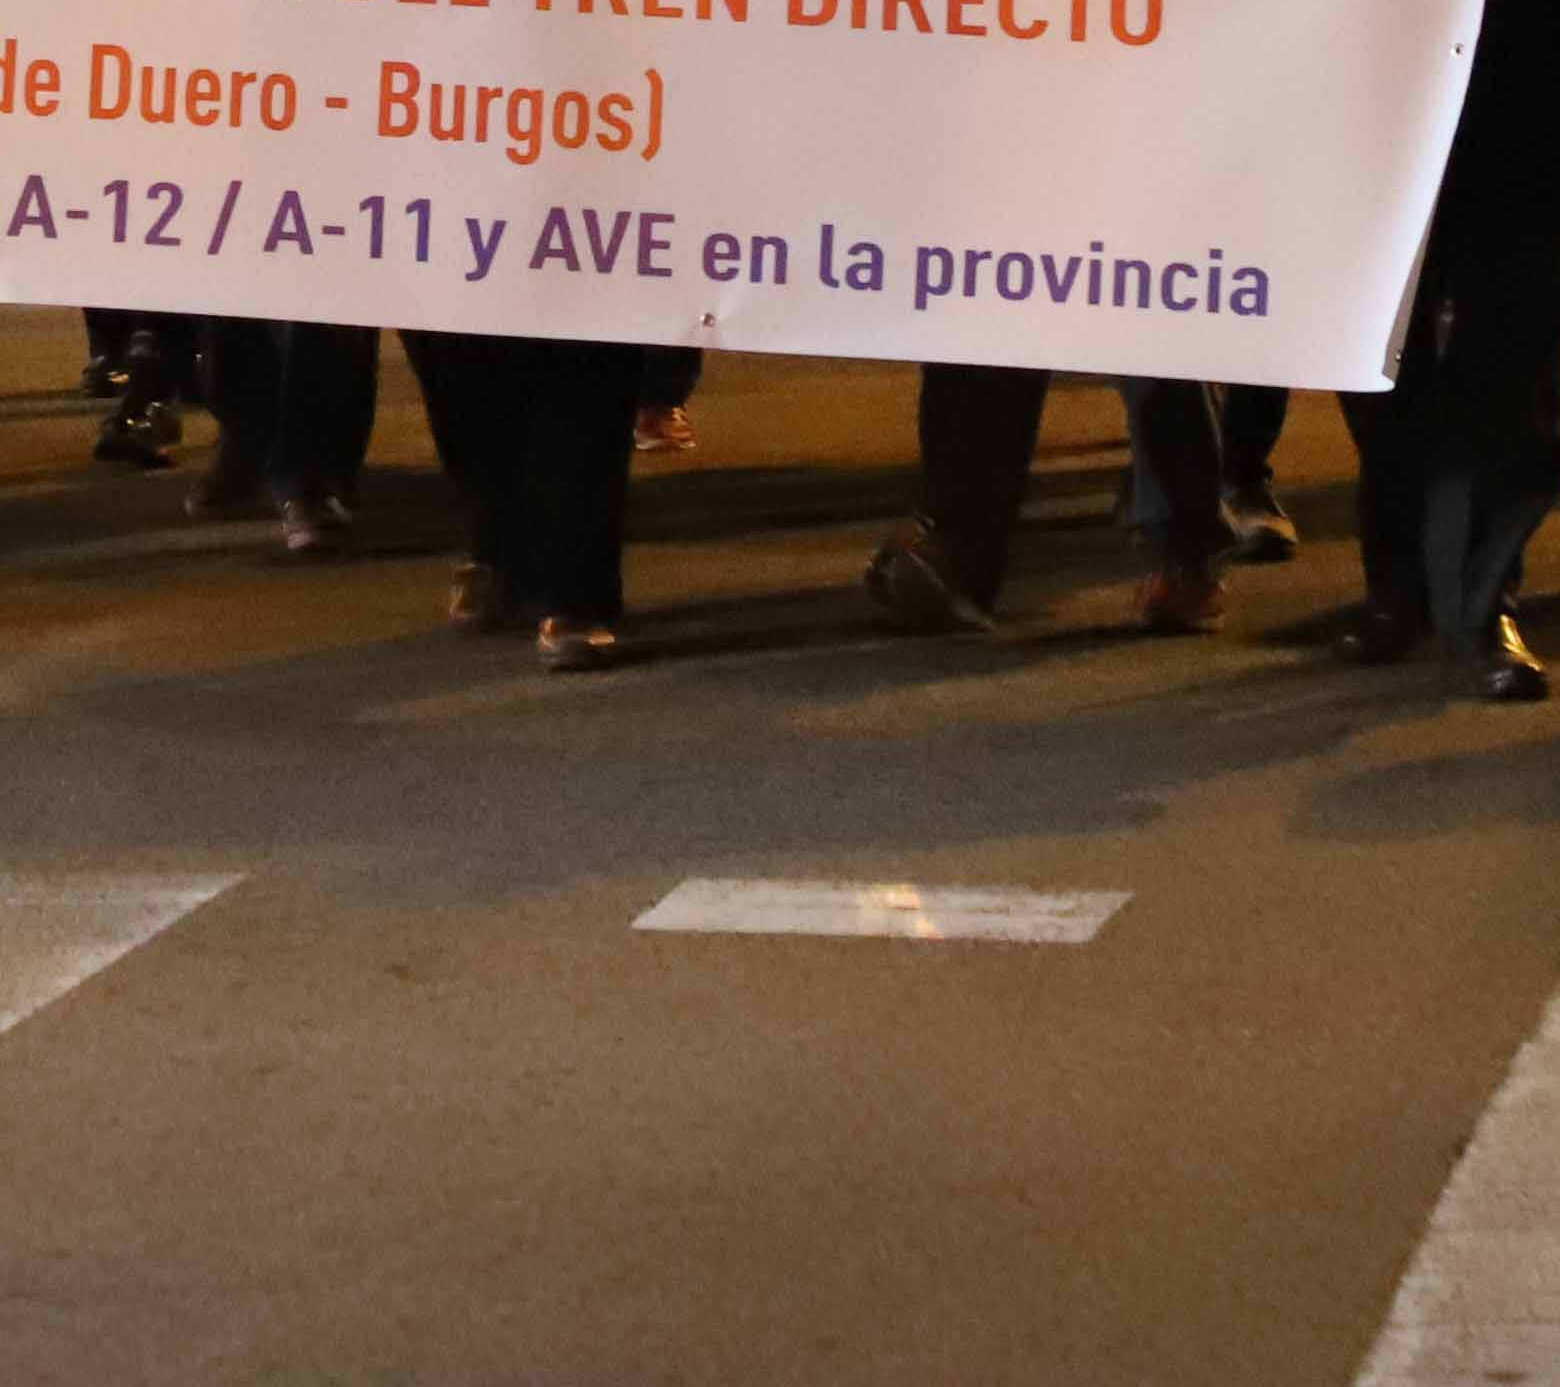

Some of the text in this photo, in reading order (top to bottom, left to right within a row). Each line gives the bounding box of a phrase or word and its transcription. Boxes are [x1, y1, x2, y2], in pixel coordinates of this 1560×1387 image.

[89, 44, 296, 131] Duero
[325, 97, 348, 109] -
[378, 61, 663, 165] Burgos)
[7, 175, 184, 246] A-12
[207, 180, 242, 255] /
[263, 190, 431, 262] A-11
[528, 206, 675, 277] AVE
[464, 218, 507, 281] y
[702, 233, 788, 285] en
[819, 224, 884, 291] la
[914, 241, 1269, 317] provincia
